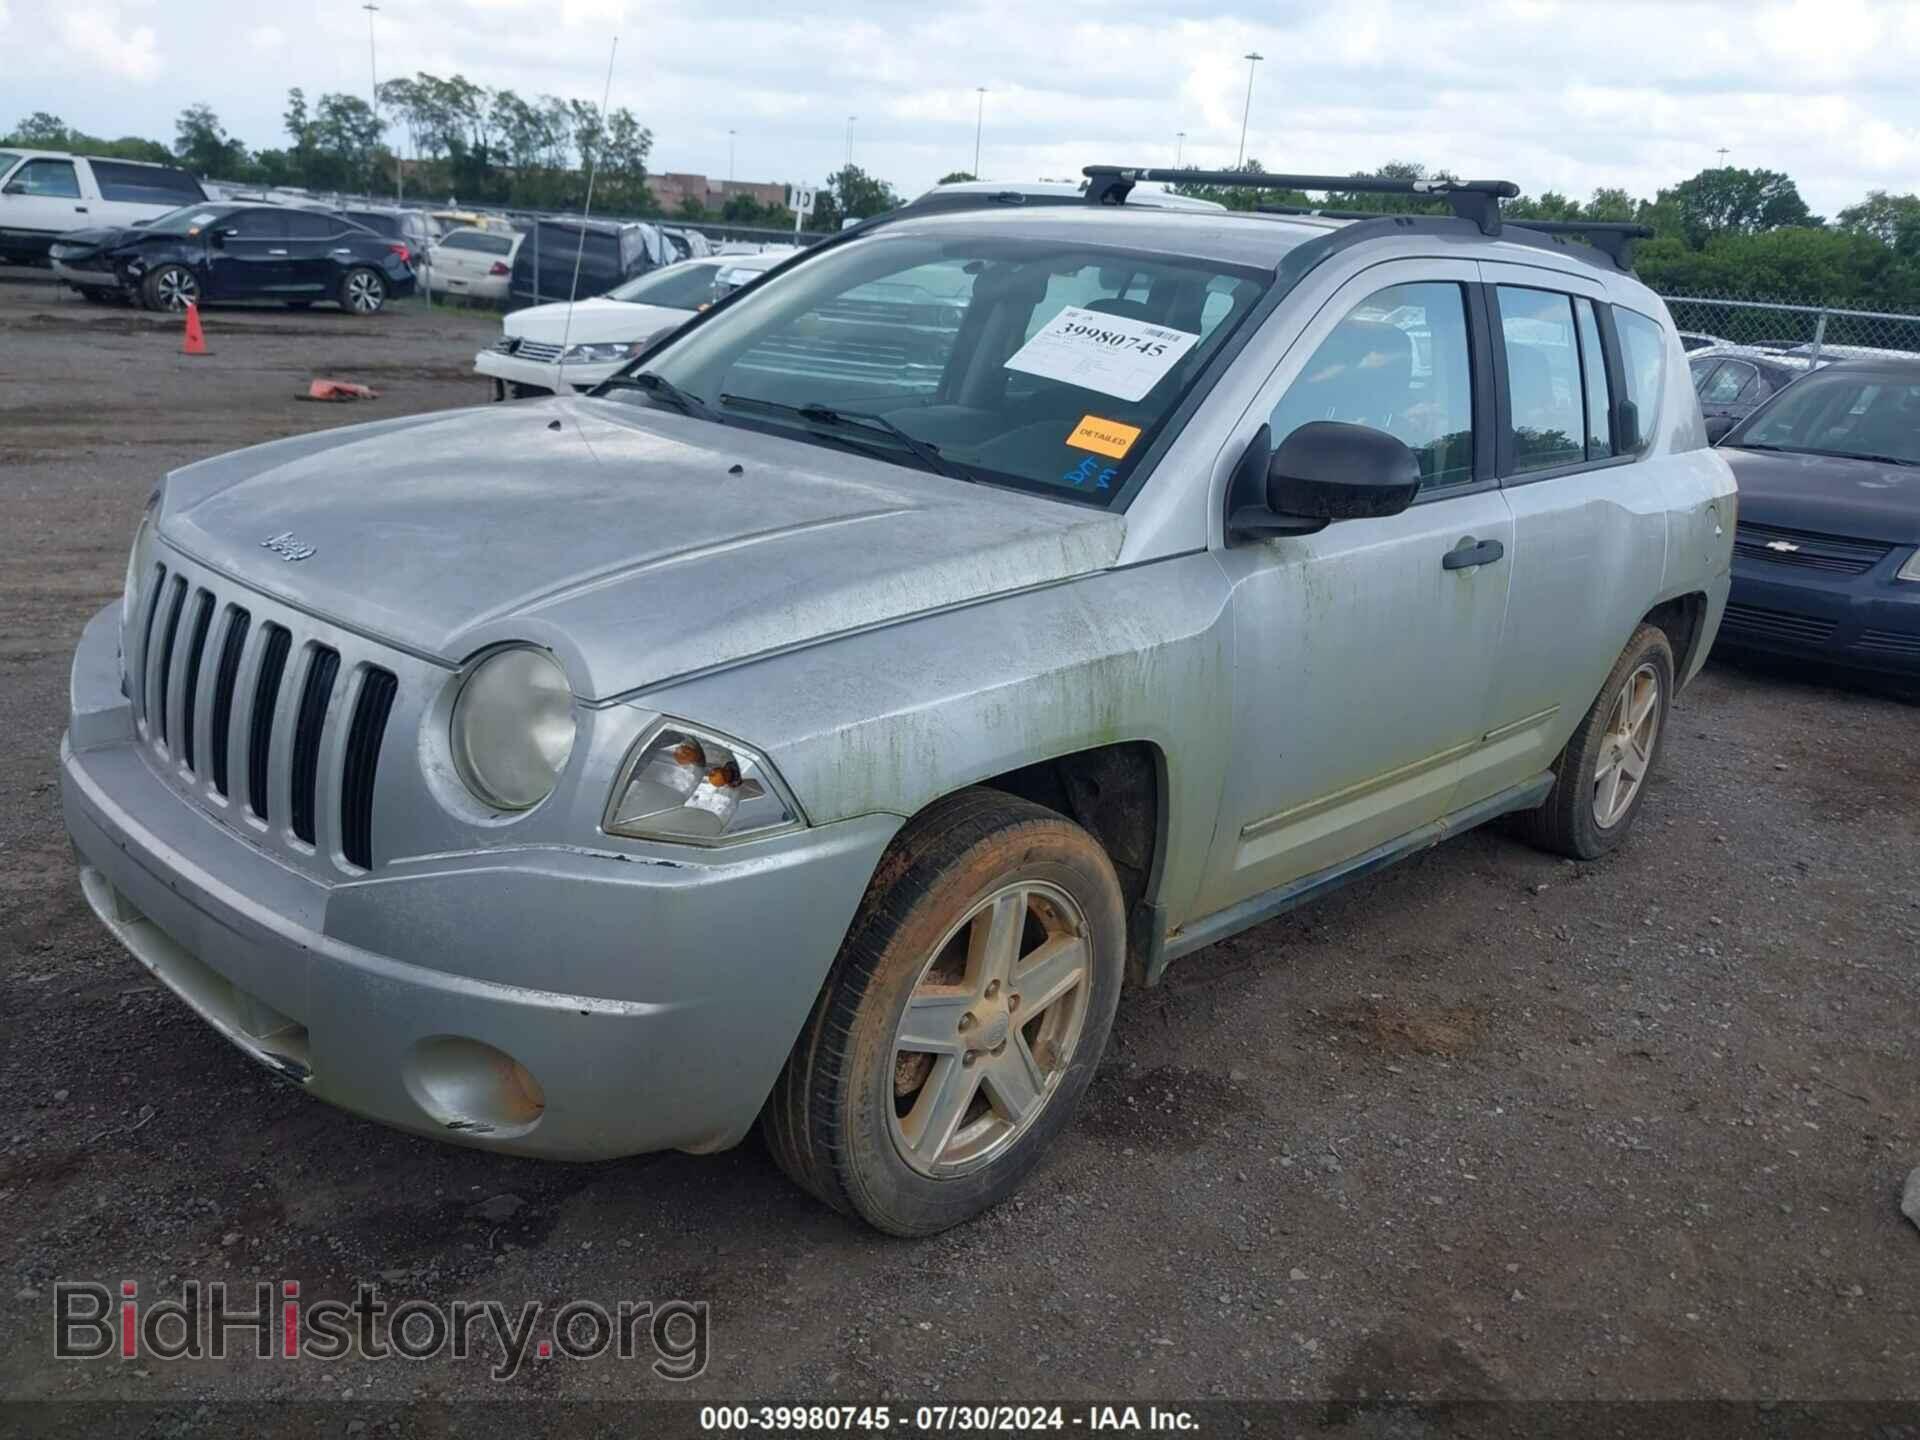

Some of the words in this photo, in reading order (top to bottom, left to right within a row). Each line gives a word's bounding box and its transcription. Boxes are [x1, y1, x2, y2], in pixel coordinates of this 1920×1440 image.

[1056, 321, 1169, 358] 39980745
[1080, 428, 1127, 446] DETAILED
[260, 531, 317, 561] Jeep
